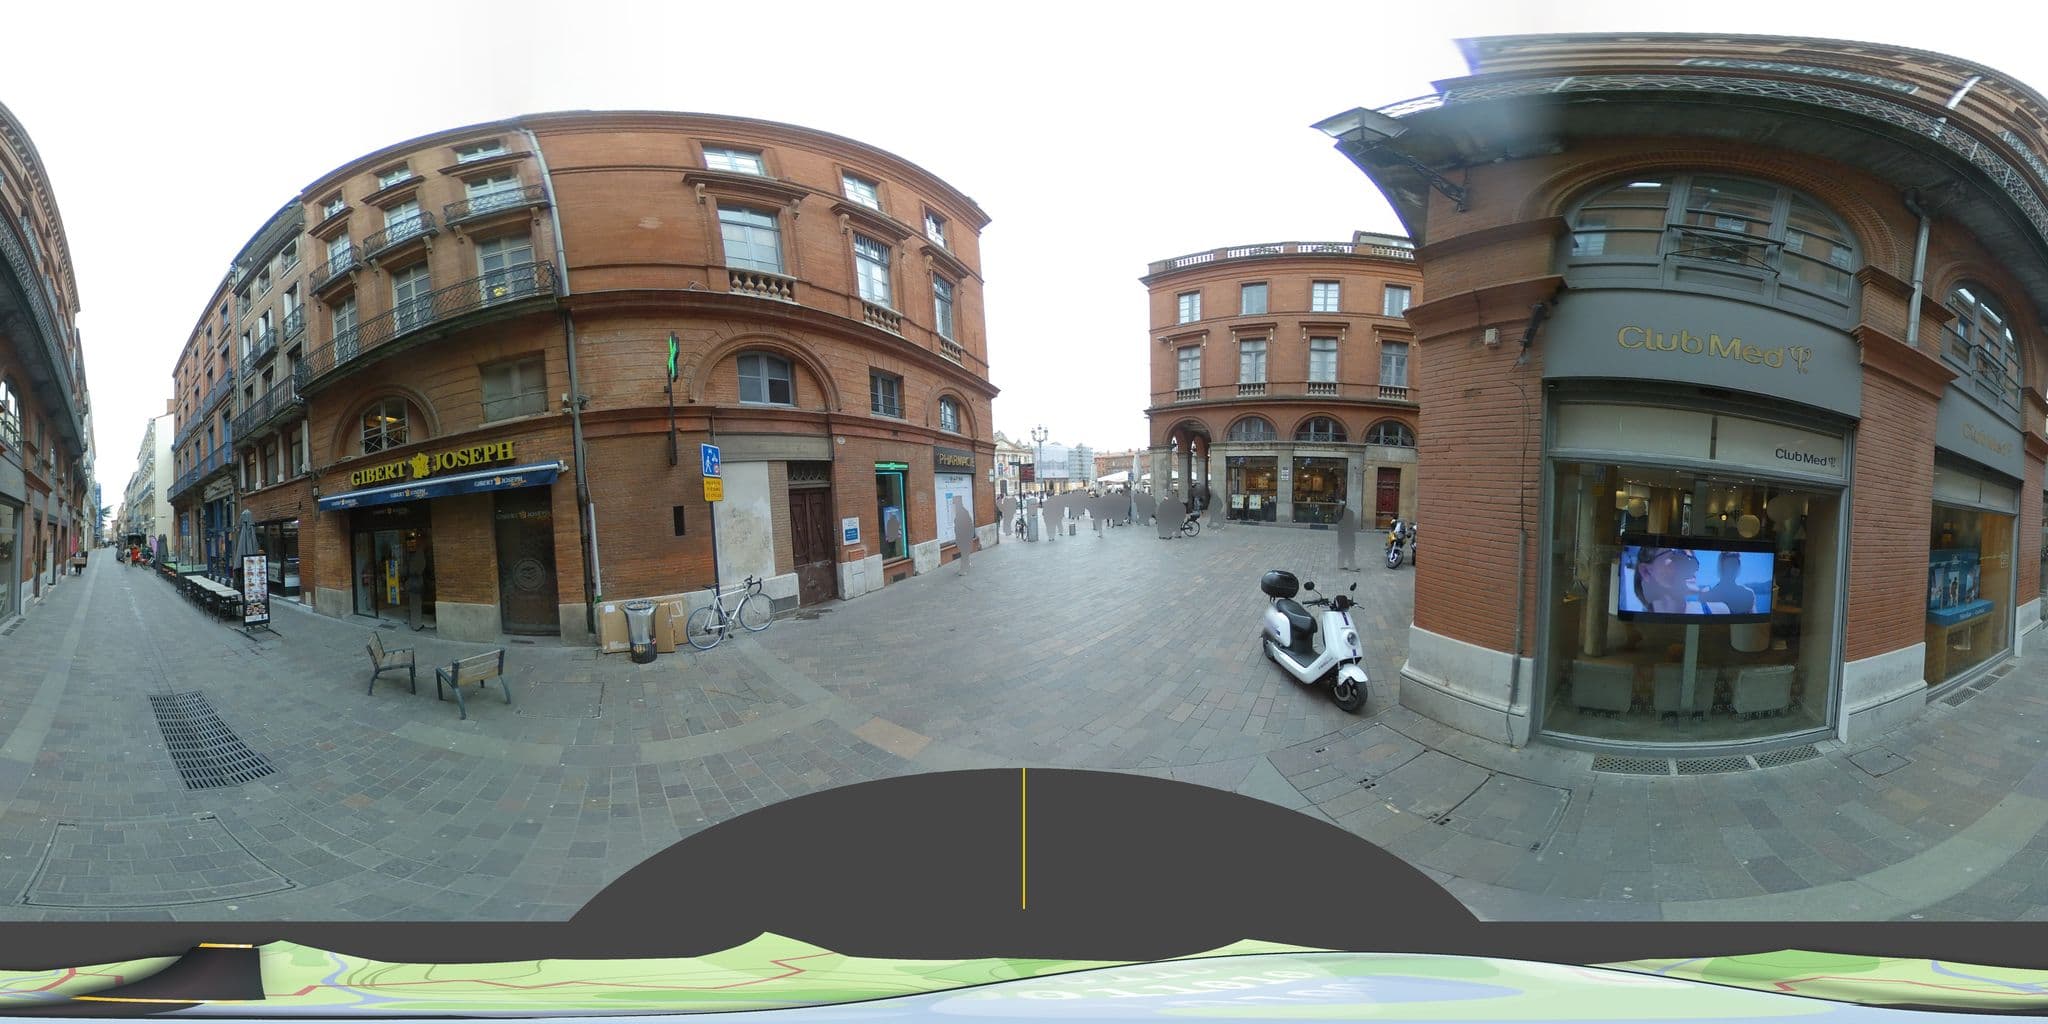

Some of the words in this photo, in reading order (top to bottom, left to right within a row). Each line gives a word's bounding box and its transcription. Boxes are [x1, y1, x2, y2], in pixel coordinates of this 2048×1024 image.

[1616, 325, 1703, 355] Club
[1708, 333, 1784, 369] Med
[351, 461, 406, 486] GIBERT
[432, 442, 515, 471] JOSEPH
[1775, 447, 1802, 463] Club
[1803, 453, 1828, 467] Med
